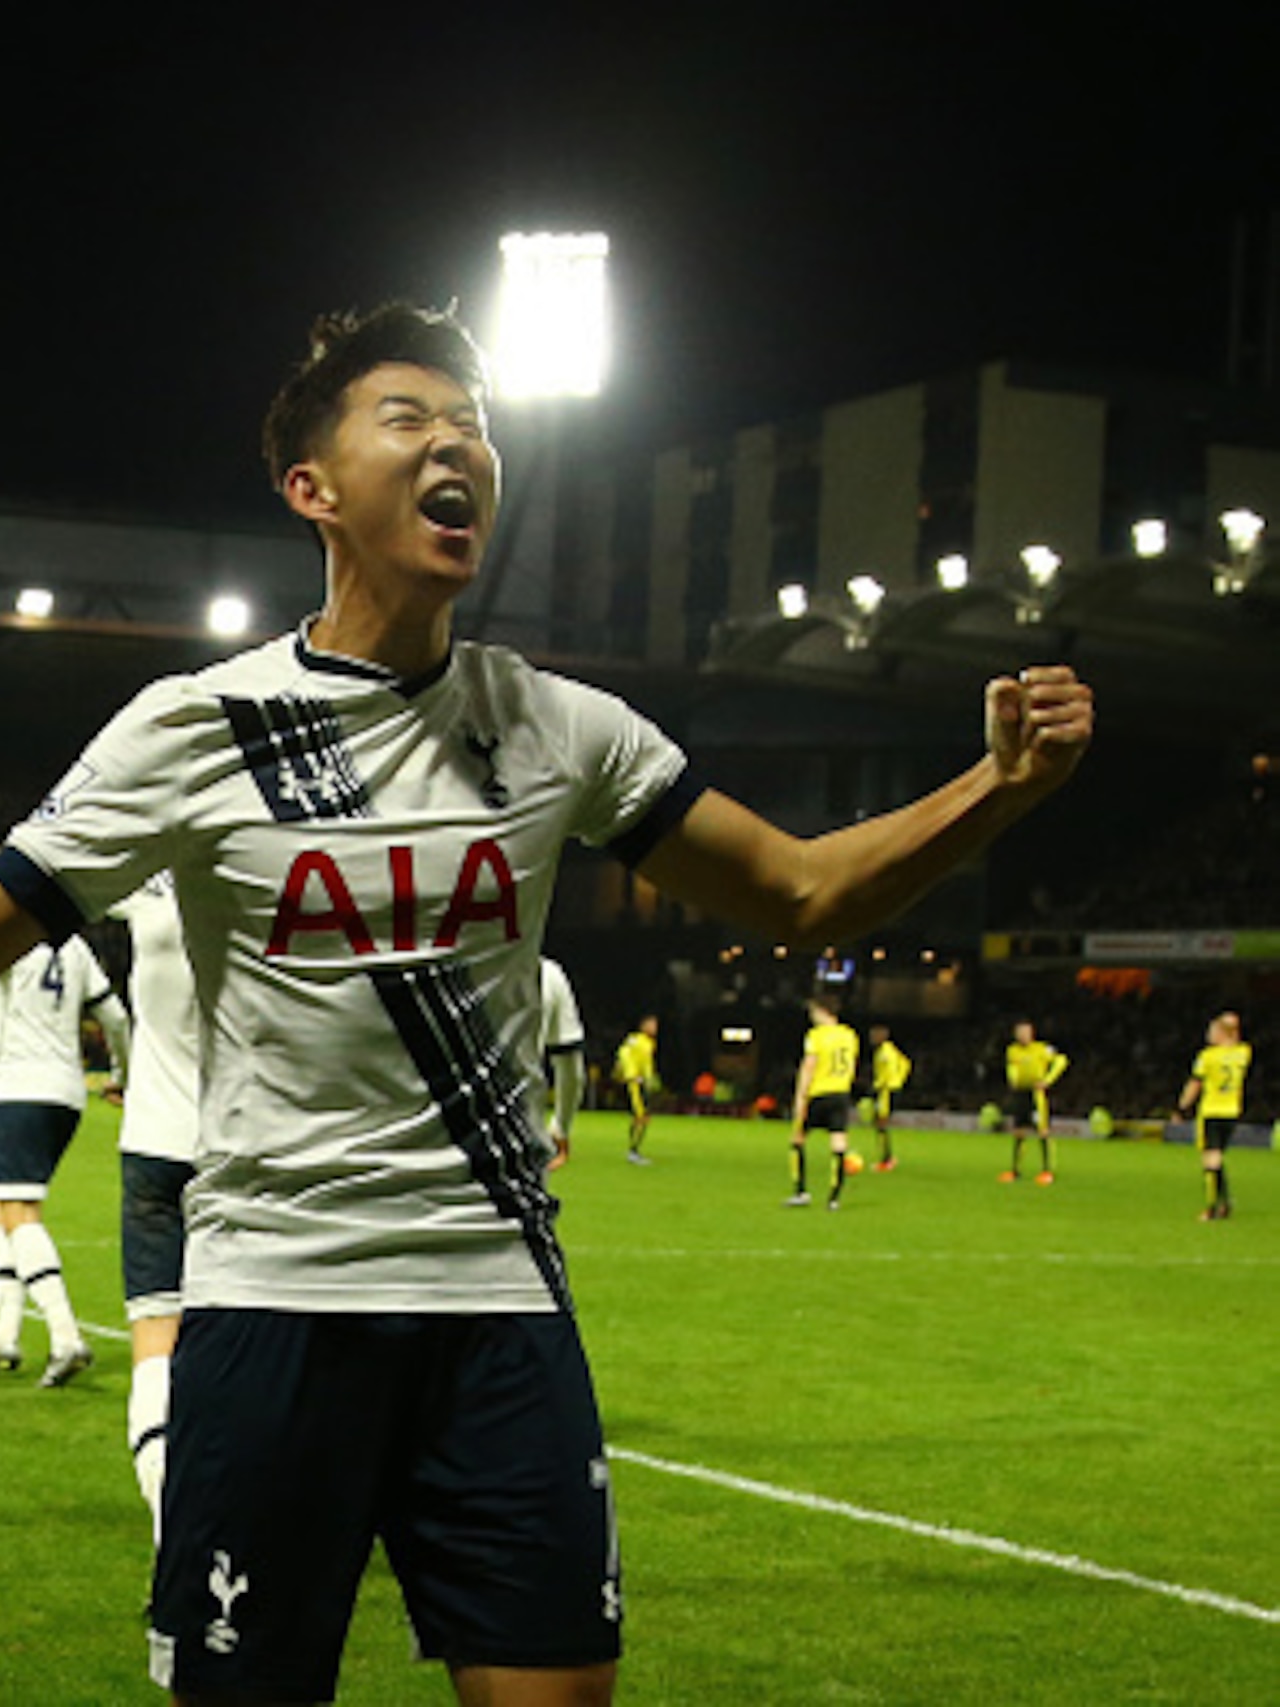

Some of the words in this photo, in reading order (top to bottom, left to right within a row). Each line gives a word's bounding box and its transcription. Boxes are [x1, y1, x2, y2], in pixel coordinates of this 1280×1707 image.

[264, 838, 520, 956] AIA
[40, 953, 64, 1012] 4
[831, 1047, 851, 1078] 15
